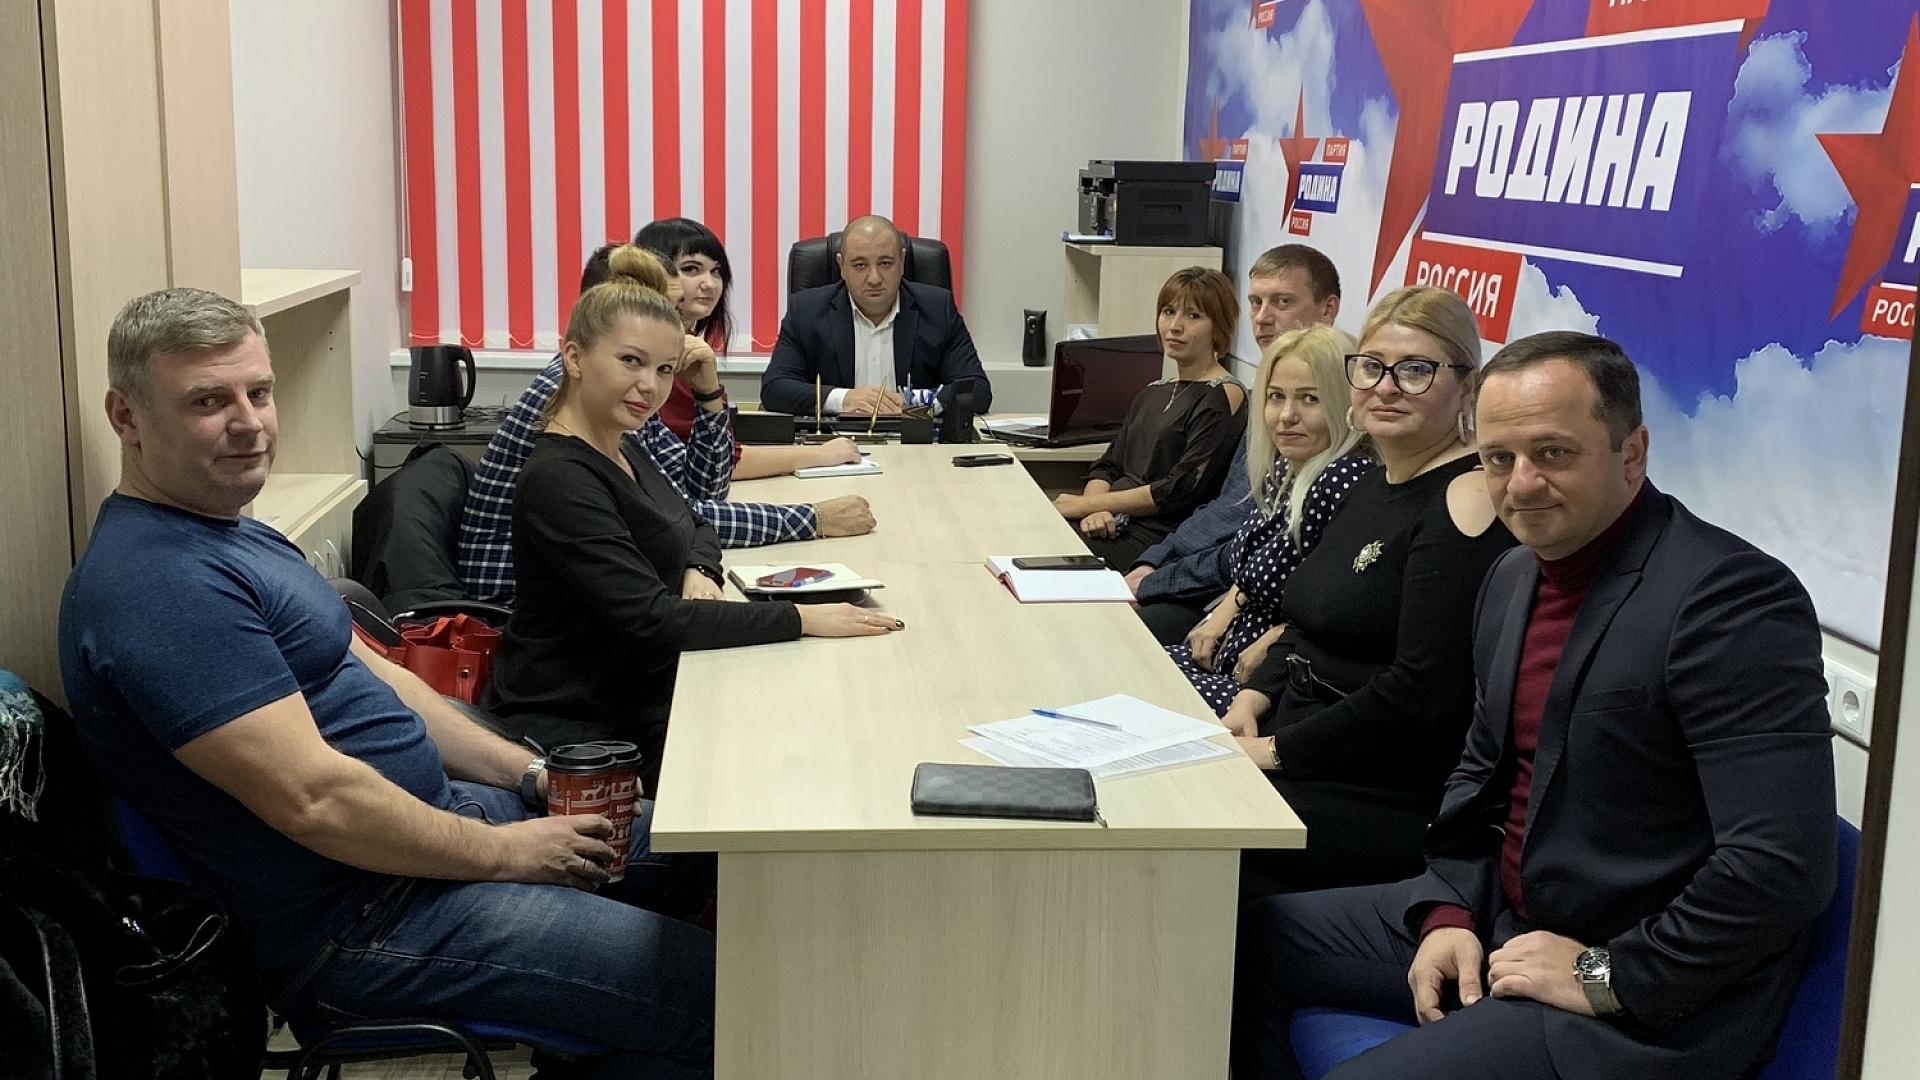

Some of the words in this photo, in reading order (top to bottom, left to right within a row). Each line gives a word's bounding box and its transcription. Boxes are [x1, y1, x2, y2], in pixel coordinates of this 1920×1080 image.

[1325, 144, 1347, 157] ПАРТИЯ
[1444, 91, 1692, 211] РОДИНА
[1298, 174, 1339, 203] РОДИНА
